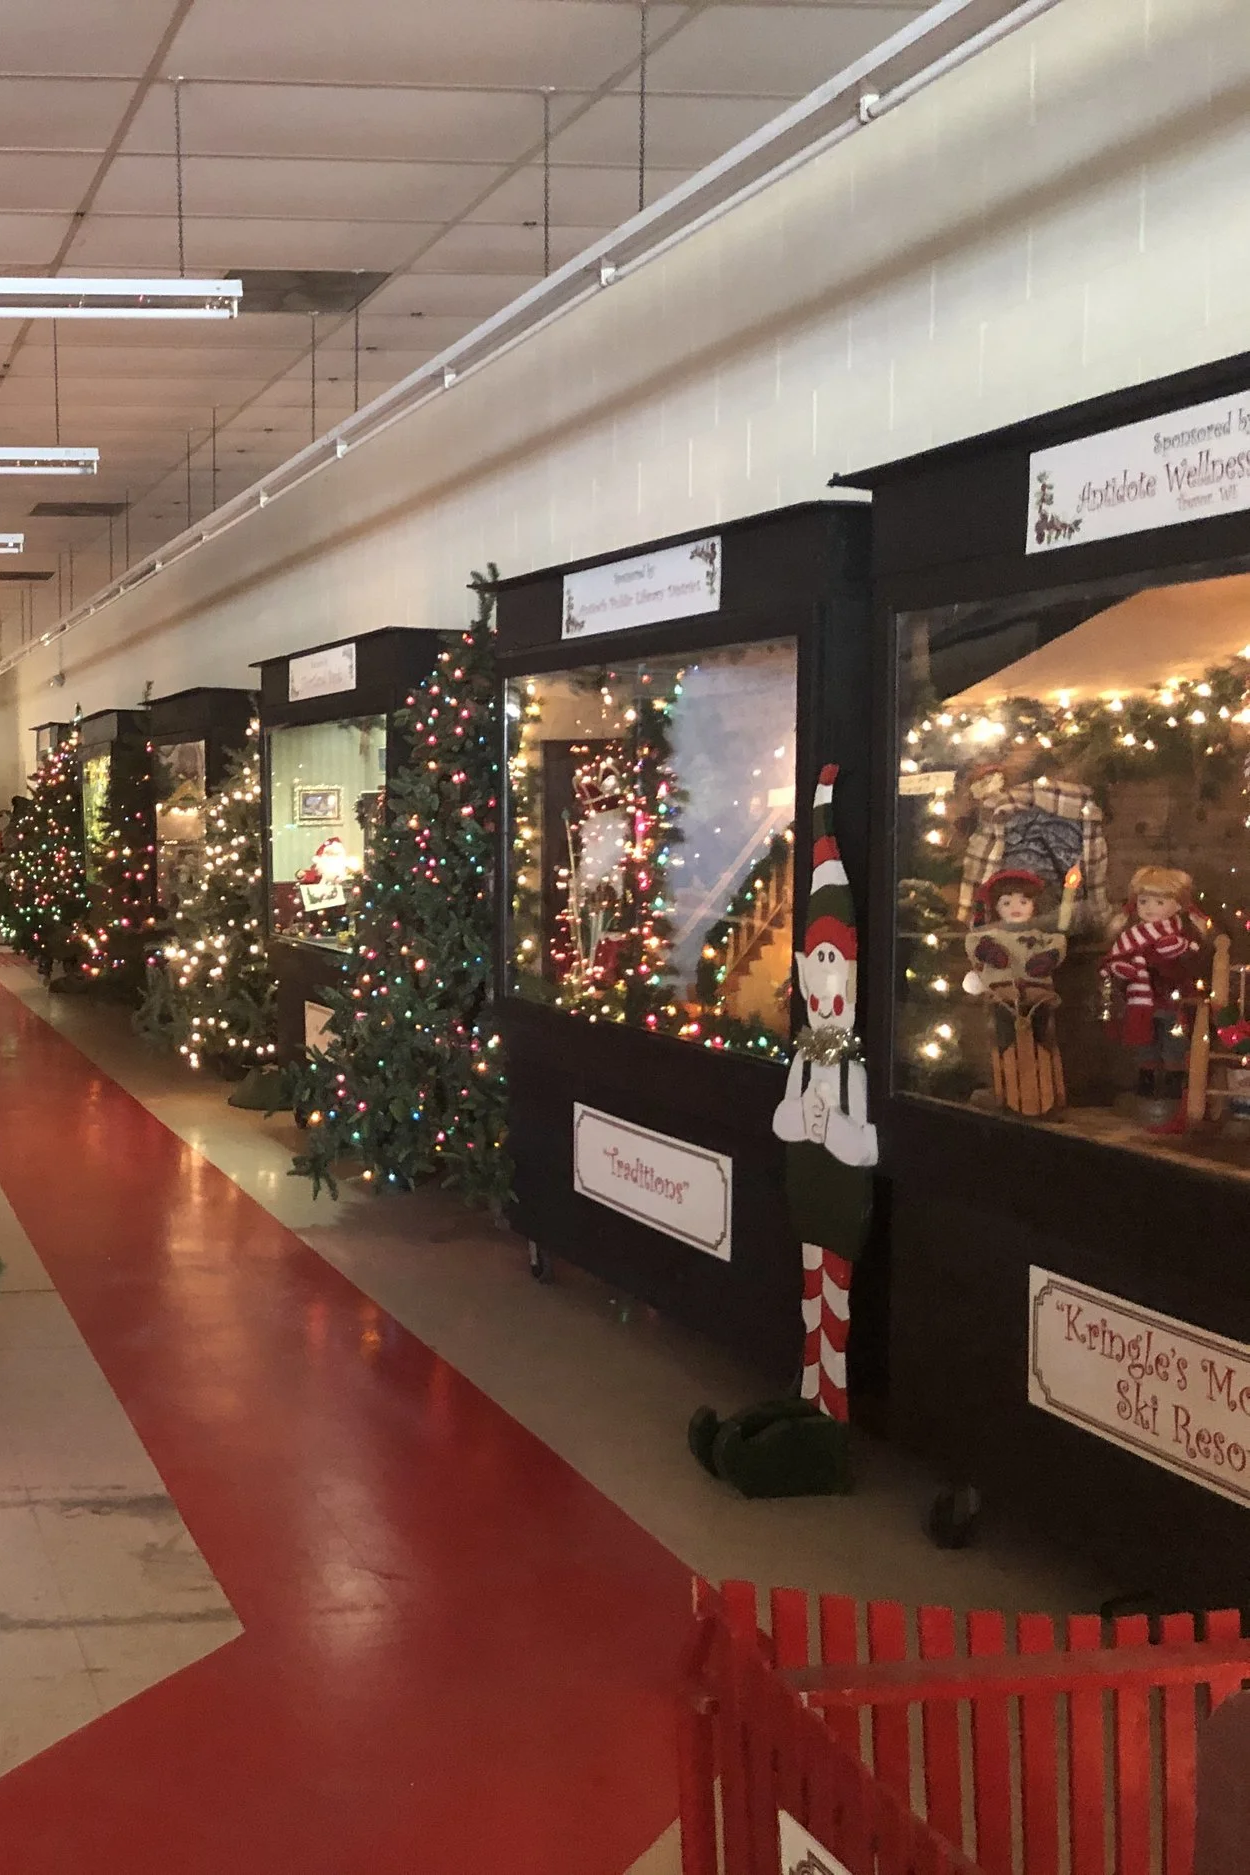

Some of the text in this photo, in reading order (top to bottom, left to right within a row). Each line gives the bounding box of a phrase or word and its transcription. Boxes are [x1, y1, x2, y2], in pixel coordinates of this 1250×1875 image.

[1153, 410, 1232, 457] Sponsored
[1076, 469, 1157, 513] Antidote
[603, 1147, 690, 1204] “Traditions”
[1055, 1300, 1189, 1391] “Kringle’s
[1116, 1378, 1250, 1472] Ski Reso
